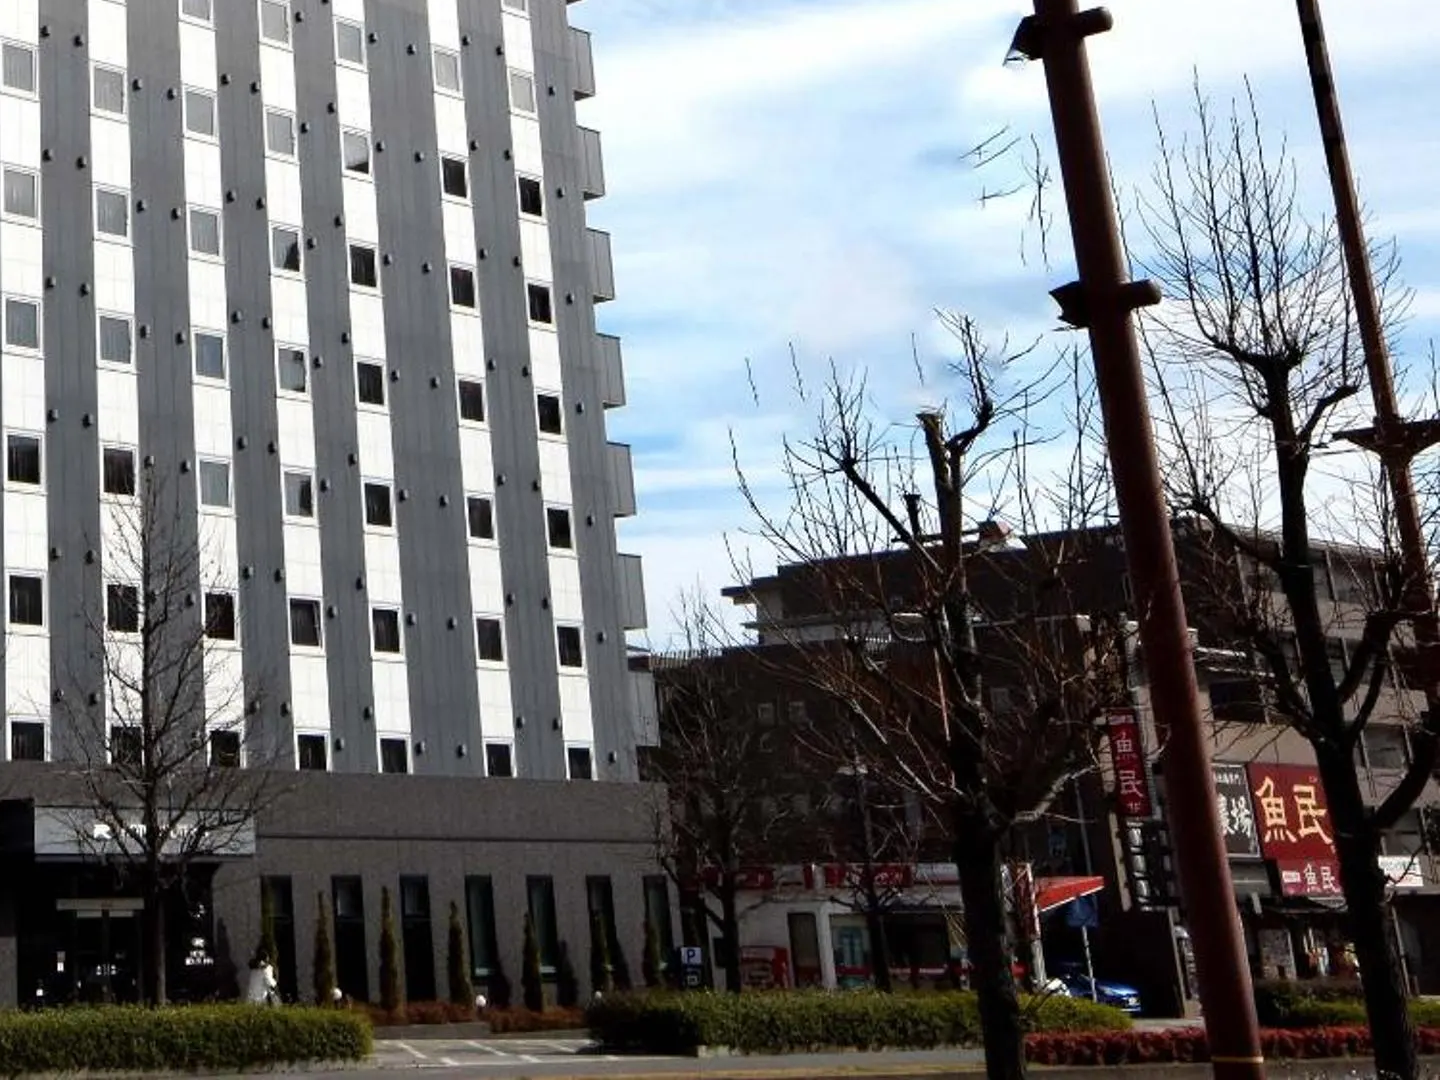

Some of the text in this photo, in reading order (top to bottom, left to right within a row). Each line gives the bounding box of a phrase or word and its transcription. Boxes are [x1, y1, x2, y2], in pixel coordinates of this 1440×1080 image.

[1115, 731, 1144, 798] 魚民
[1255, 776, 1335, 844] 魚民
[1302, 863, 1342, 894] 魚民
[686, 948, 696, 962] P
